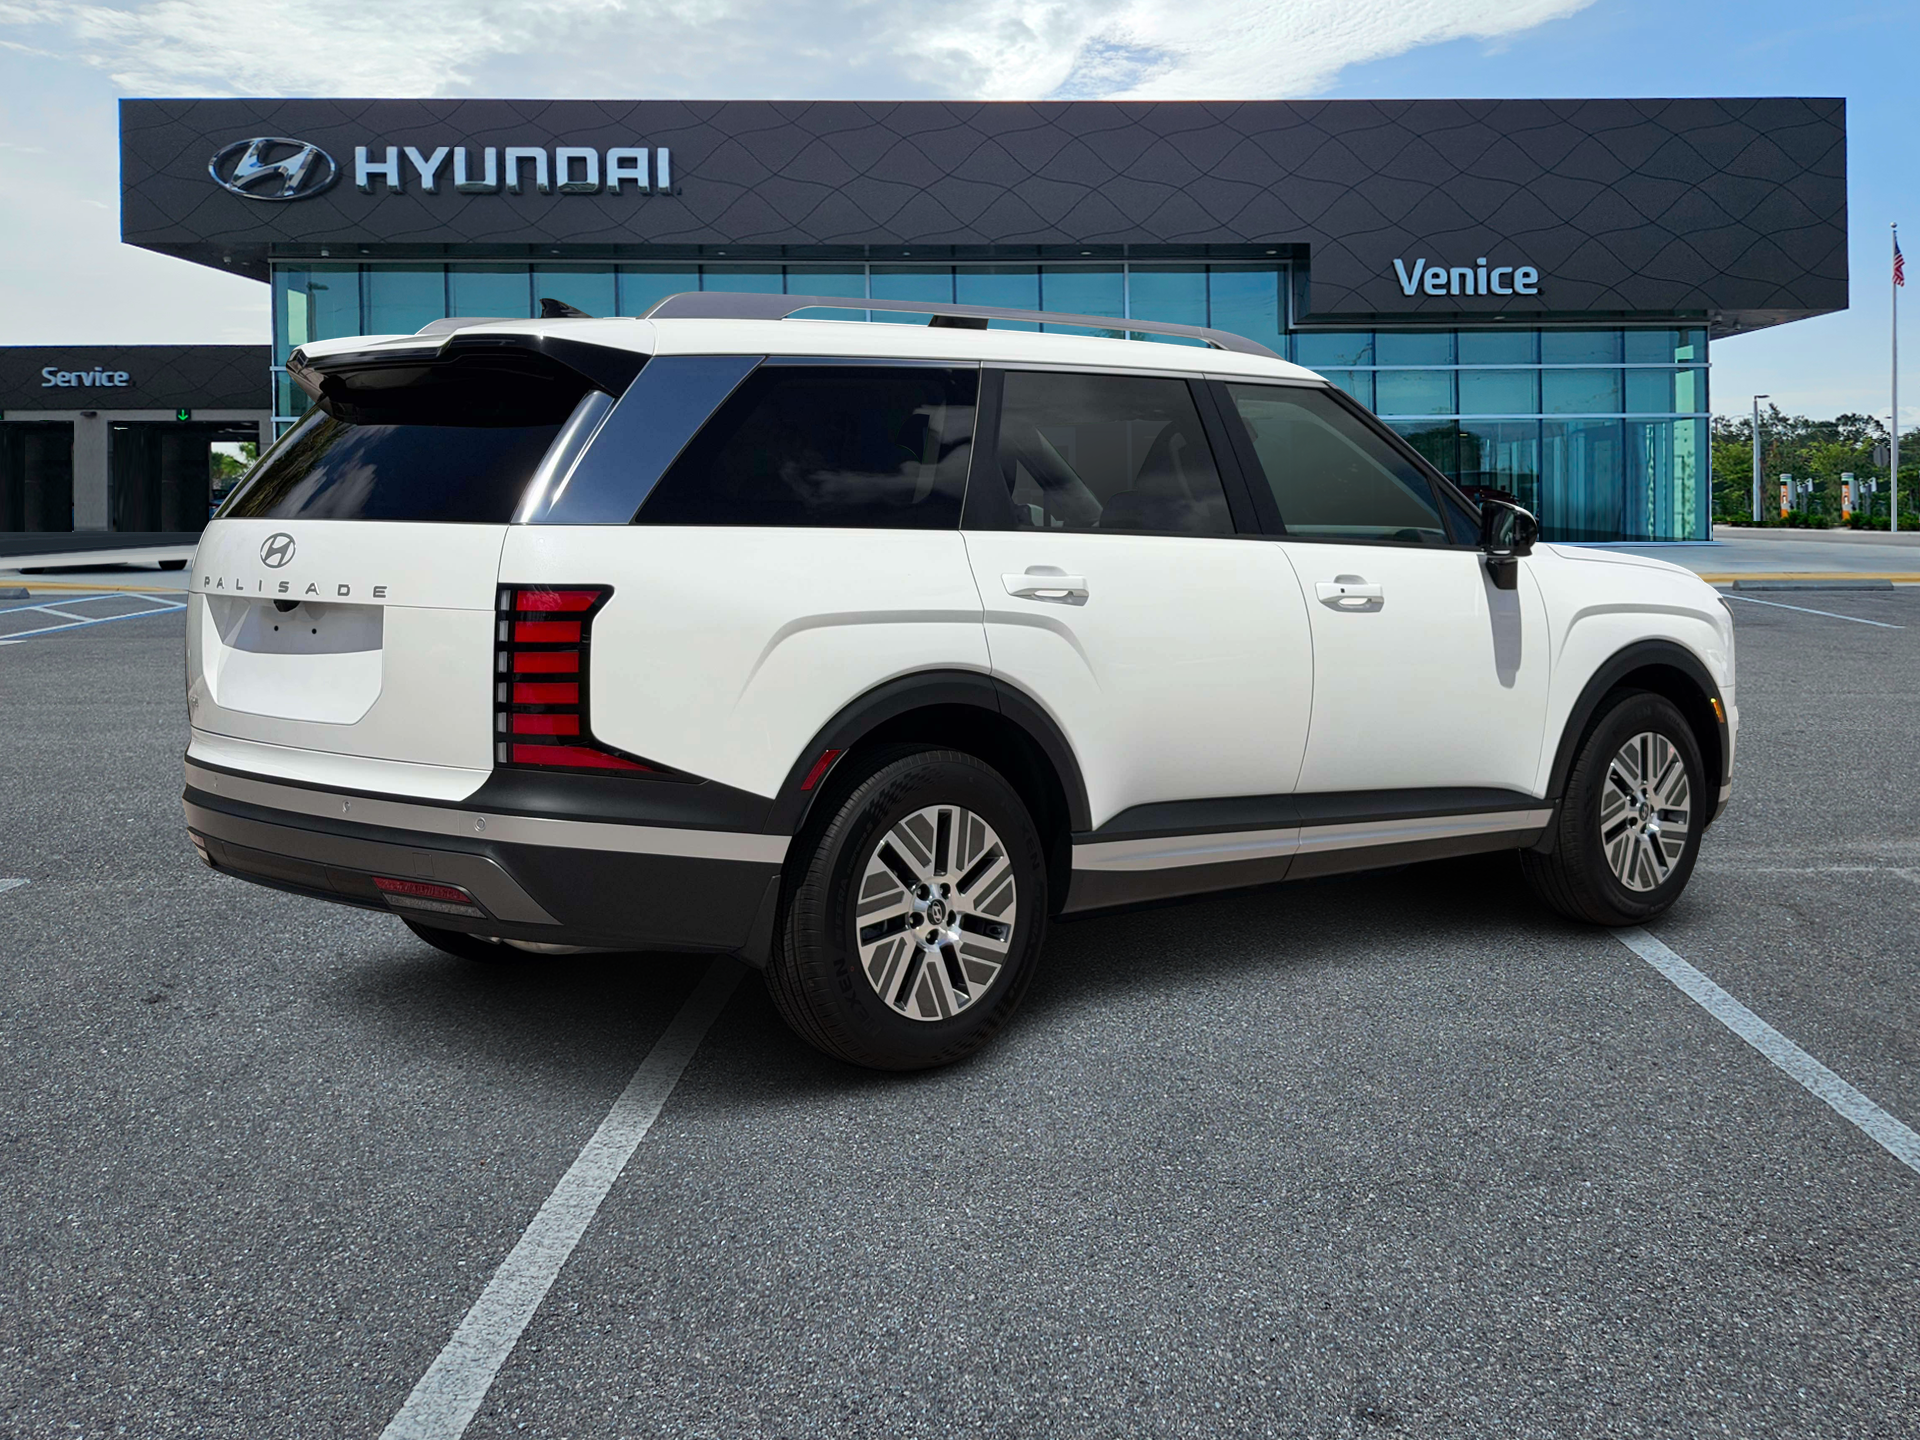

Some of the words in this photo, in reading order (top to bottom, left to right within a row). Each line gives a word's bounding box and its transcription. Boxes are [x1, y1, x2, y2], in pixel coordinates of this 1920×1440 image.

[354, 146, 673, 195] HYUNDAI
[1393, 257, 1539, 296] Venice
[41, 366, 130, 387] Service
[204, 576, 387, 598] PALISADE
